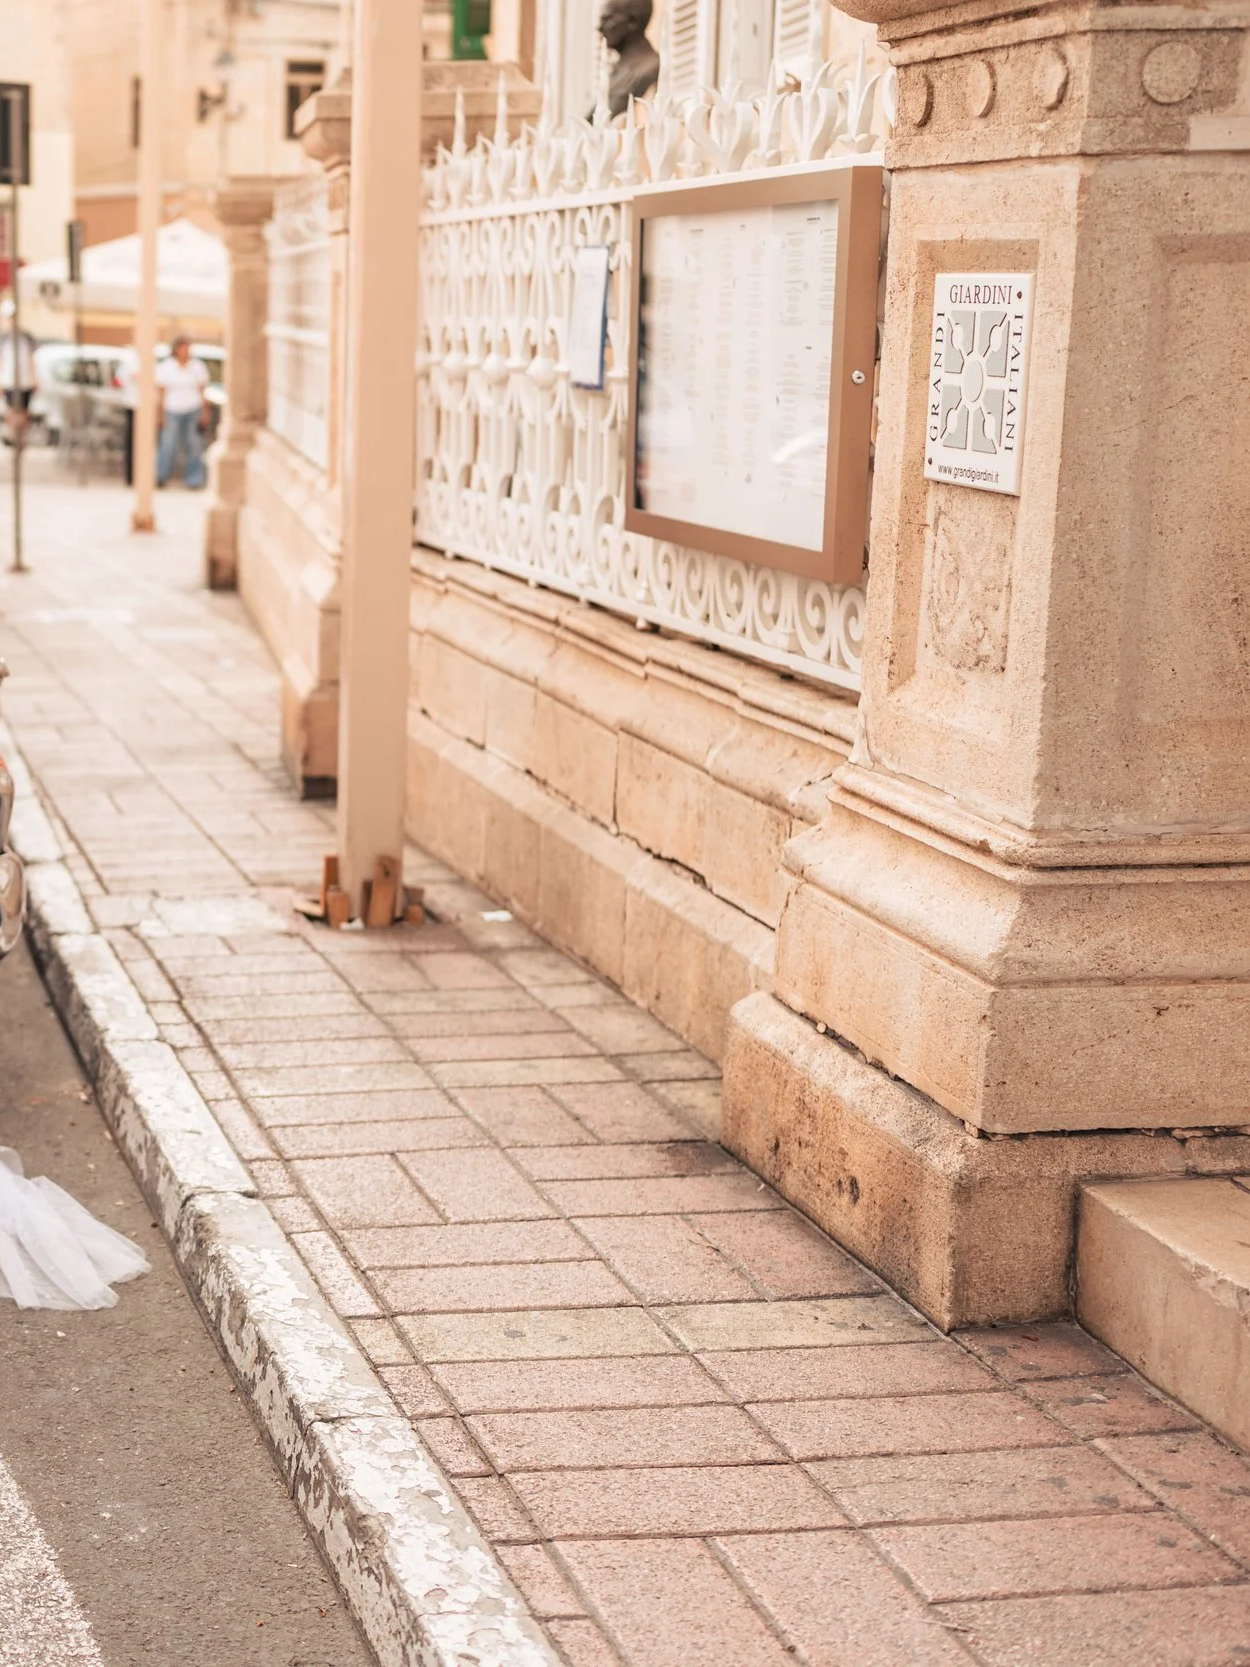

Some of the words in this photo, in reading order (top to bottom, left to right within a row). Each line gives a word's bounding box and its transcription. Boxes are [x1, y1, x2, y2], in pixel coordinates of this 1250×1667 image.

[950, 285, 1013, 304] GIARDINI
[929, 312, 945, 442] GRANDI
[1004, 314, 1024, 451] ITALIANI
[938, 465, 999, 483] www.grandigiardini.it
